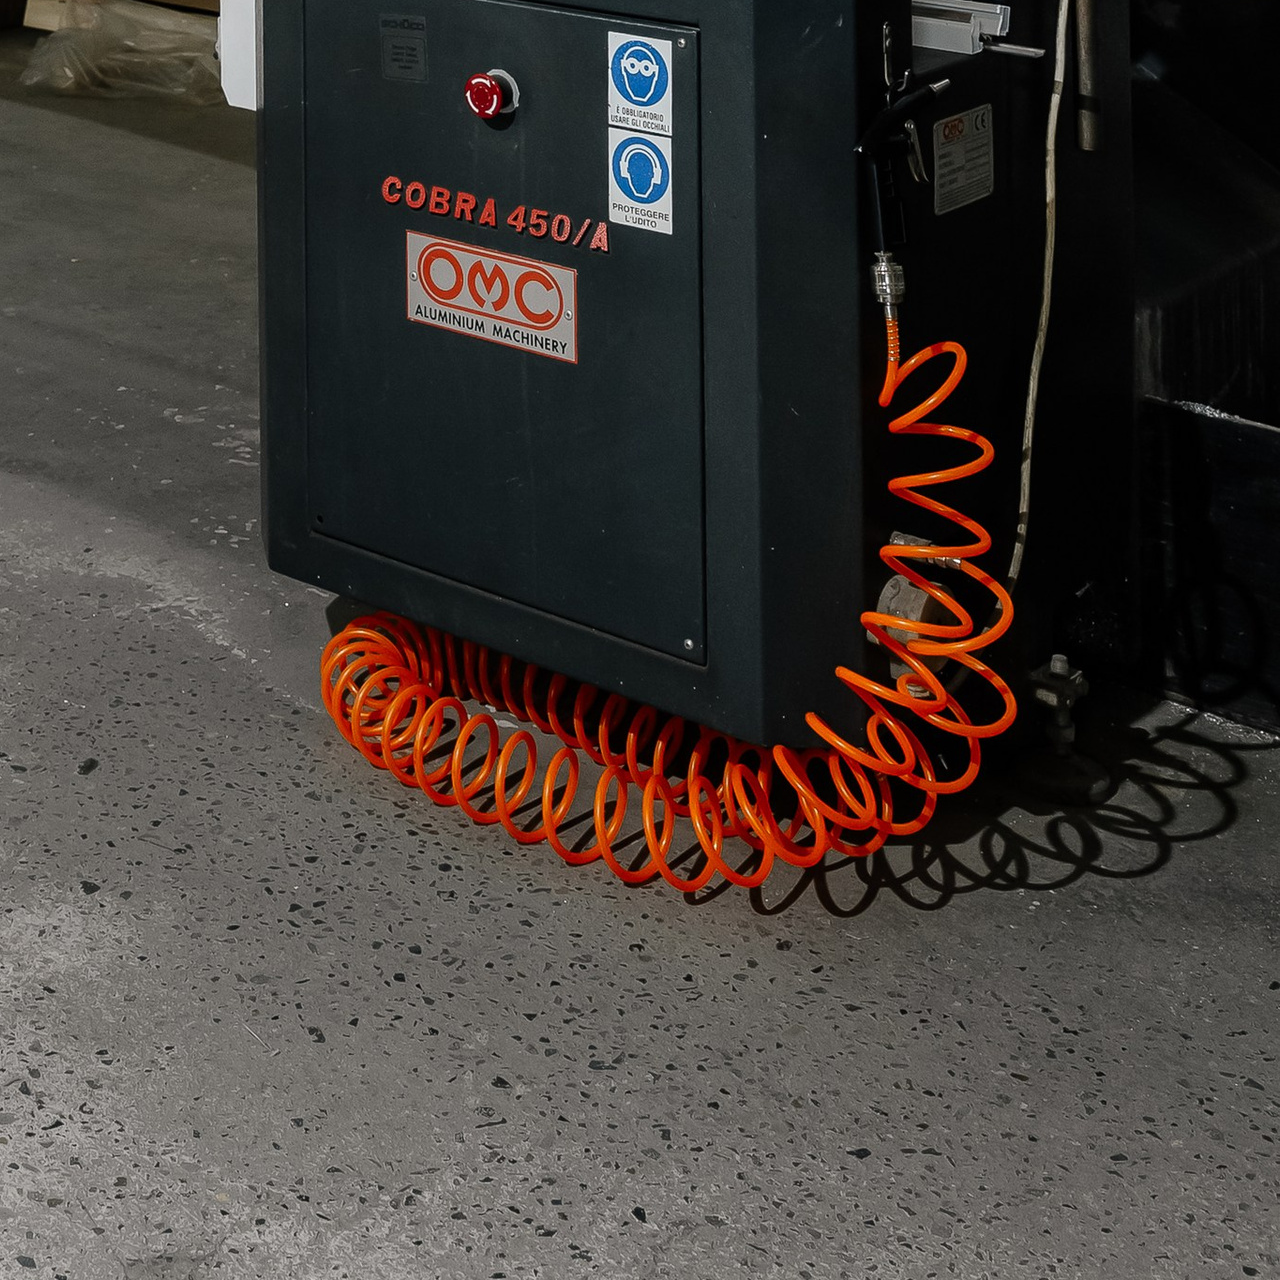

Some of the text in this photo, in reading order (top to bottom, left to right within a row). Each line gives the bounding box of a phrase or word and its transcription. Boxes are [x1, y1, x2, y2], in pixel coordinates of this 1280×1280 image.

[610, 114, 670, 132] USARE GLI OCCHIALI
[621, 106, 664, 122] OBBLIGATORIO
[974, 112, 987, 131] CE
[381, 176, 609, 252] COBRA 450/A
[612, 202, 670, 222] PROTEGGERE
[624, 214, 657, 228] L'UDITO
[422, 248, 555, 324] OMC
[414, 304, 568, 355] ALUMINIUM MACHINERY
